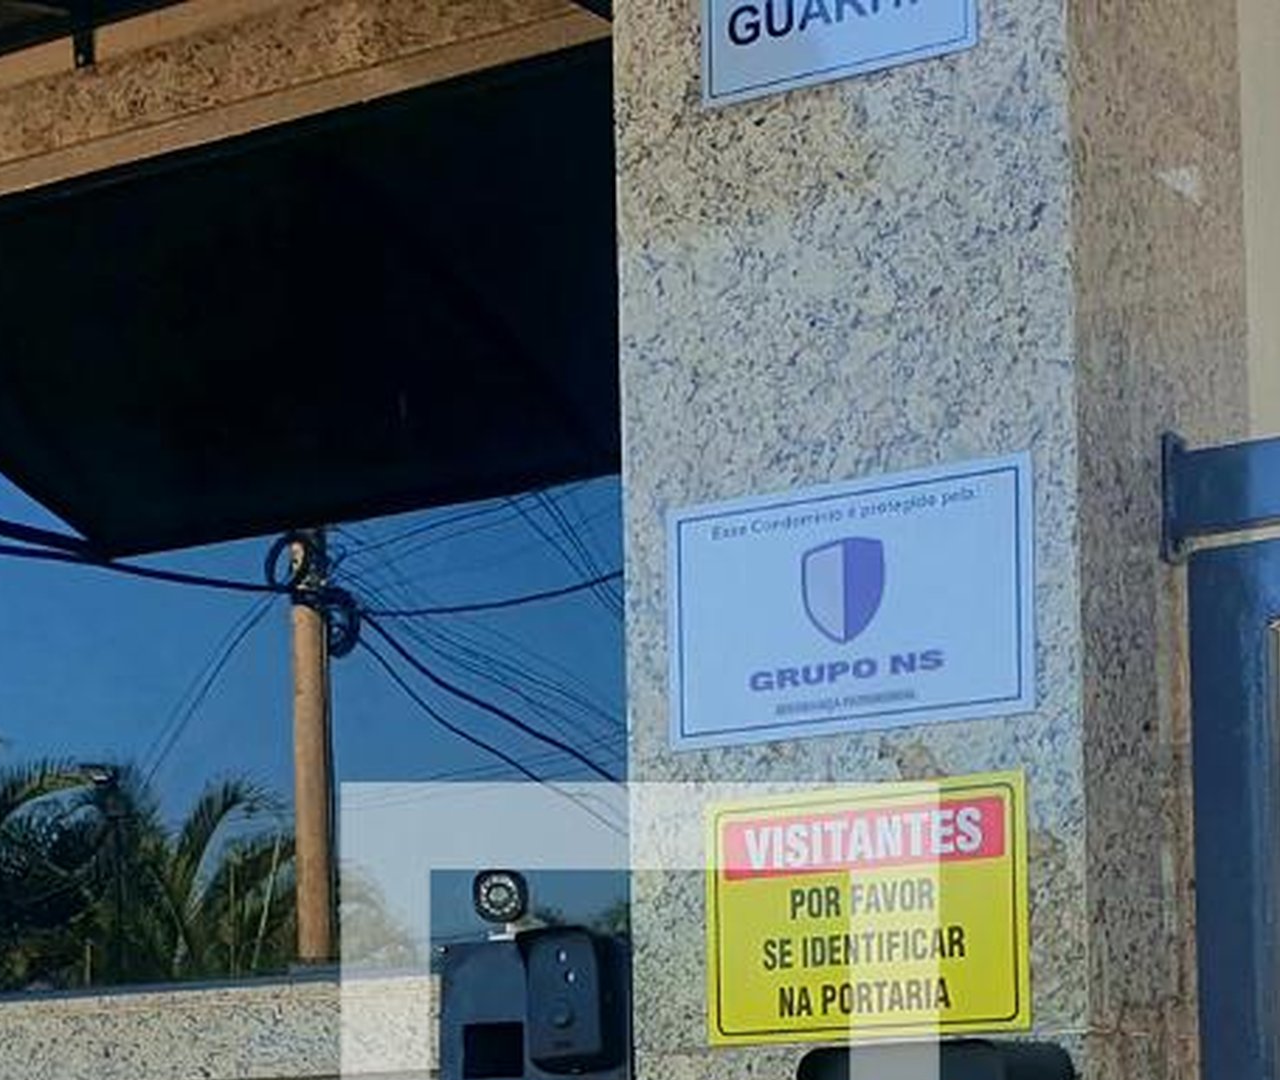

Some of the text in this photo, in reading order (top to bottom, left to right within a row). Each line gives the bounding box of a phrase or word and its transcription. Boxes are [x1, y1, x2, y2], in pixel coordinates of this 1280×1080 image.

[860, 495, 936, 518] protegido
[749, 649, 945, 692] GRUPO NS
[744, 806, 984, 870] VISITANTES
[790, 878, 935, 920] POR FAVOR
[763, 926, 965, 971] SE IDENTIFICAR
[779, 978, 951, 1018] NA PORTARIA
